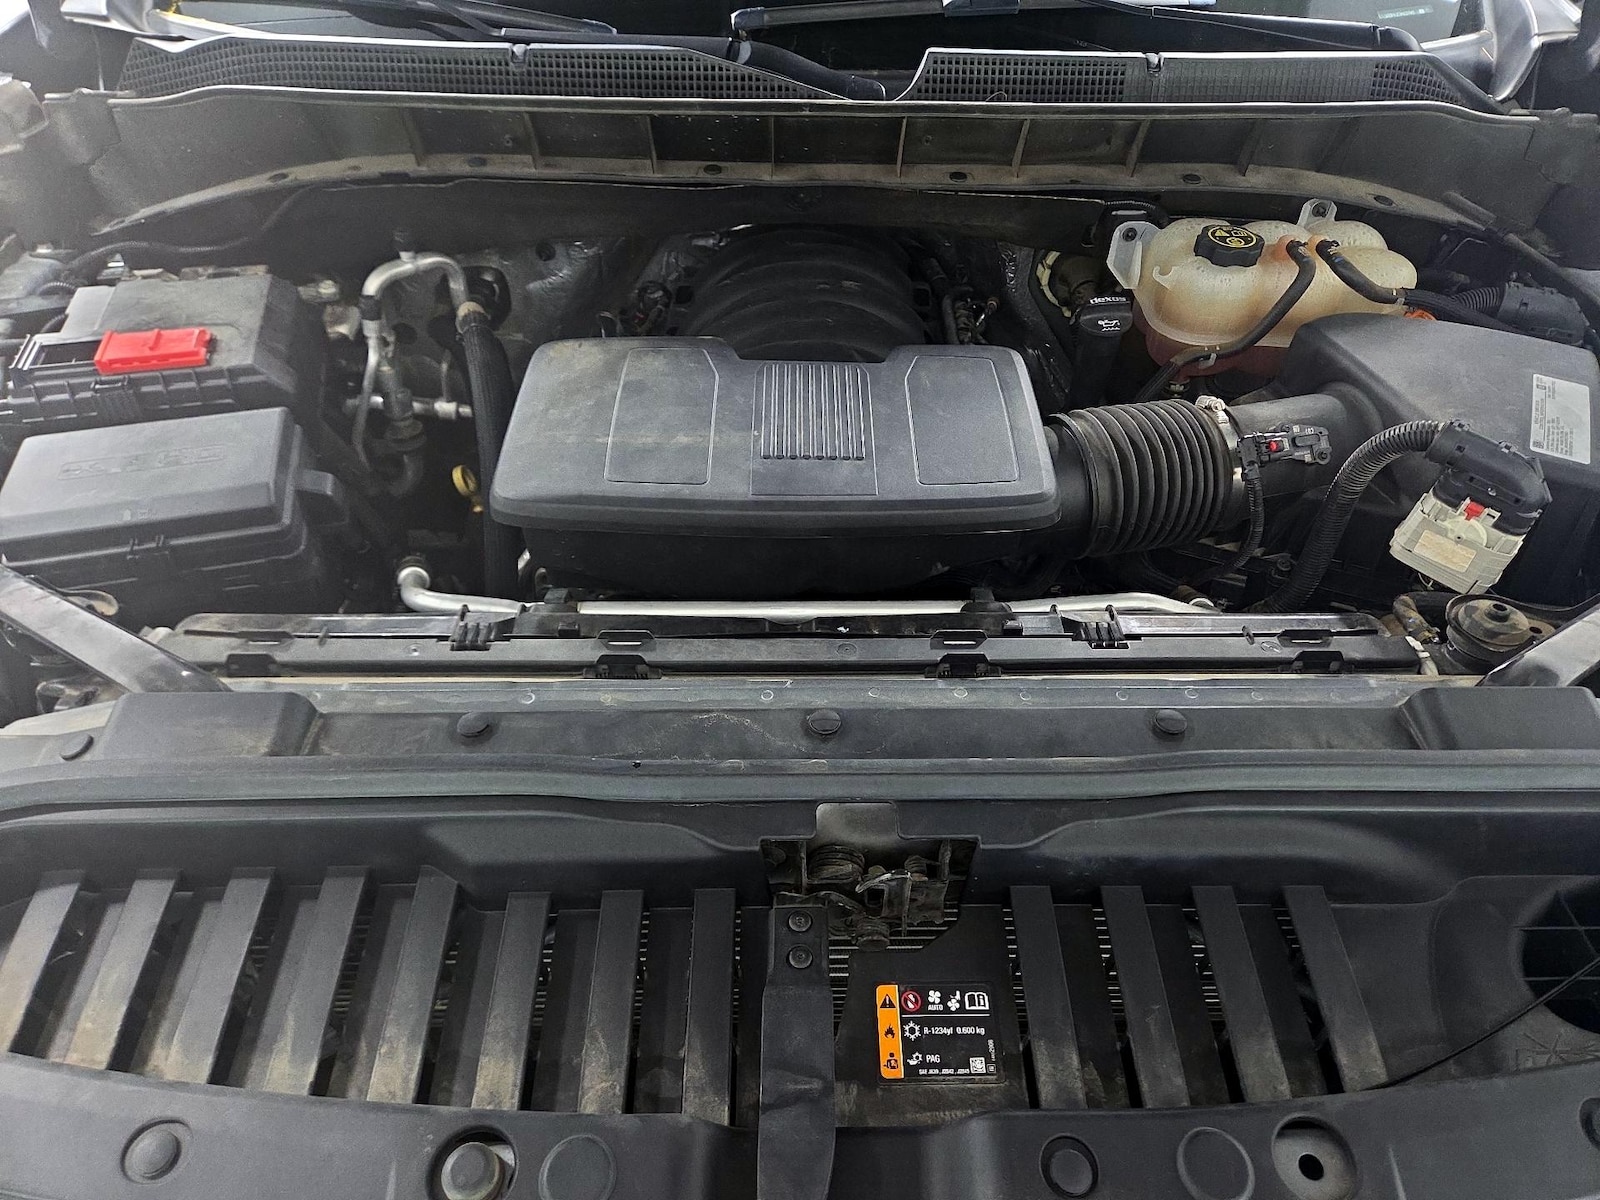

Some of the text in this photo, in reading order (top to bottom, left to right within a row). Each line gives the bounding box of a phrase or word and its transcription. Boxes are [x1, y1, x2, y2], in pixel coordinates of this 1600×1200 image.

[923, 1026, 985, 1036] R-1234yf 0.600 kg
[926, 1054, 941, 1063] PAG
